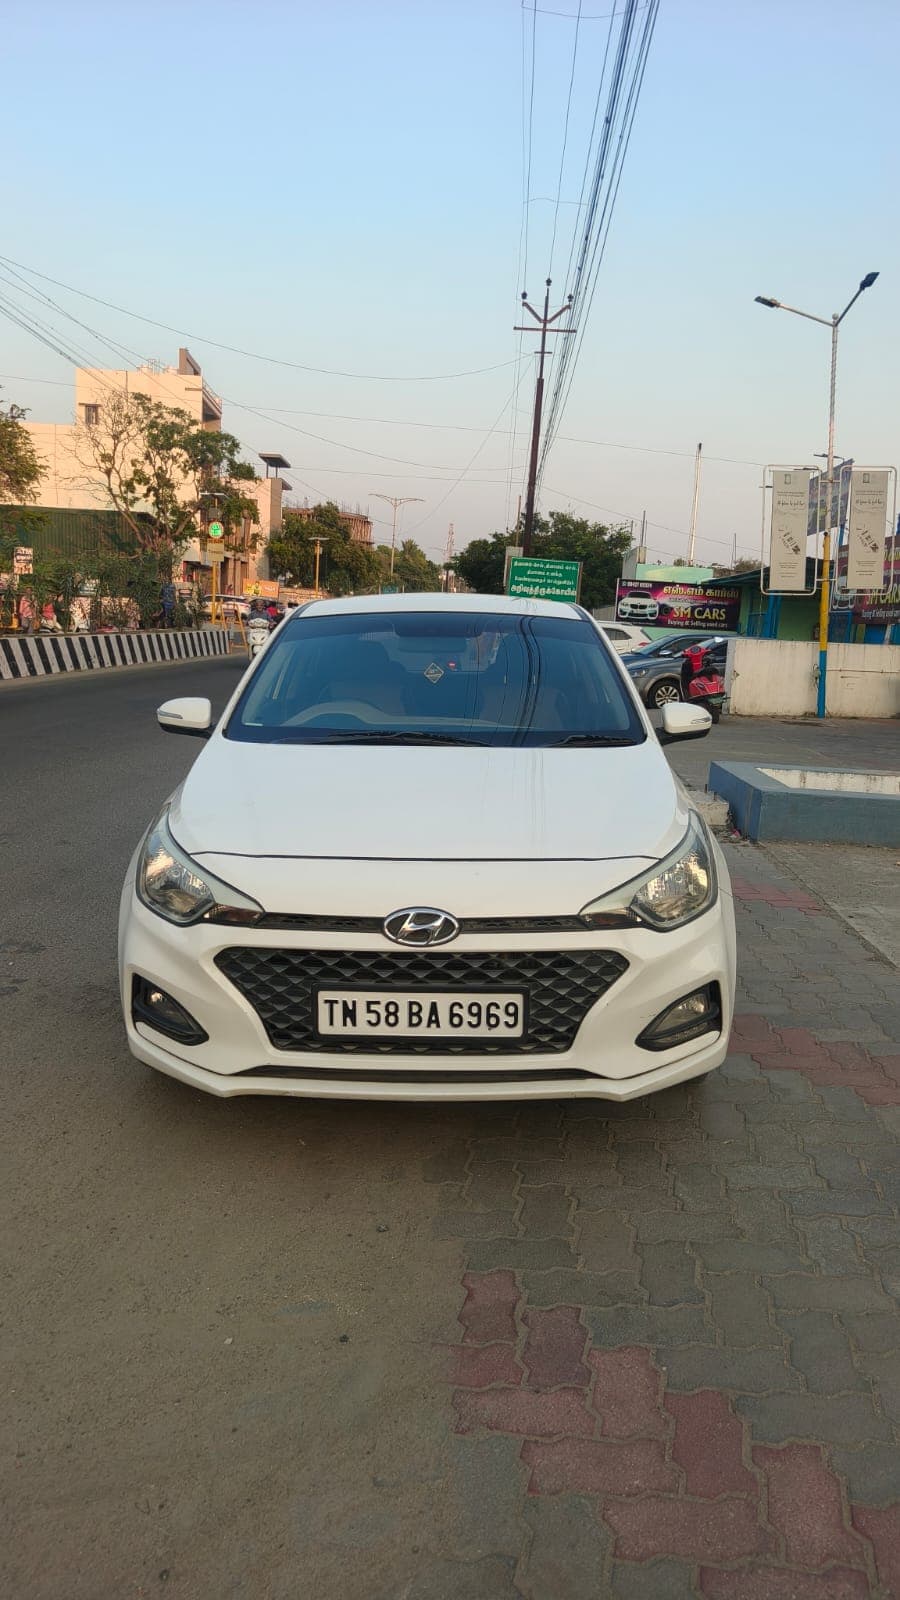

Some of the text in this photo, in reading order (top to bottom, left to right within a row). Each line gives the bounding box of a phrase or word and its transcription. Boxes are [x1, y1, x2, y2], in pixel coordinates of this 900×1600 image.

[673, 606, 726, 620] SM CARS
[667, 619, 684, 627] Buying
[324, 999, 519, 1029] TN 58 BA 6969
